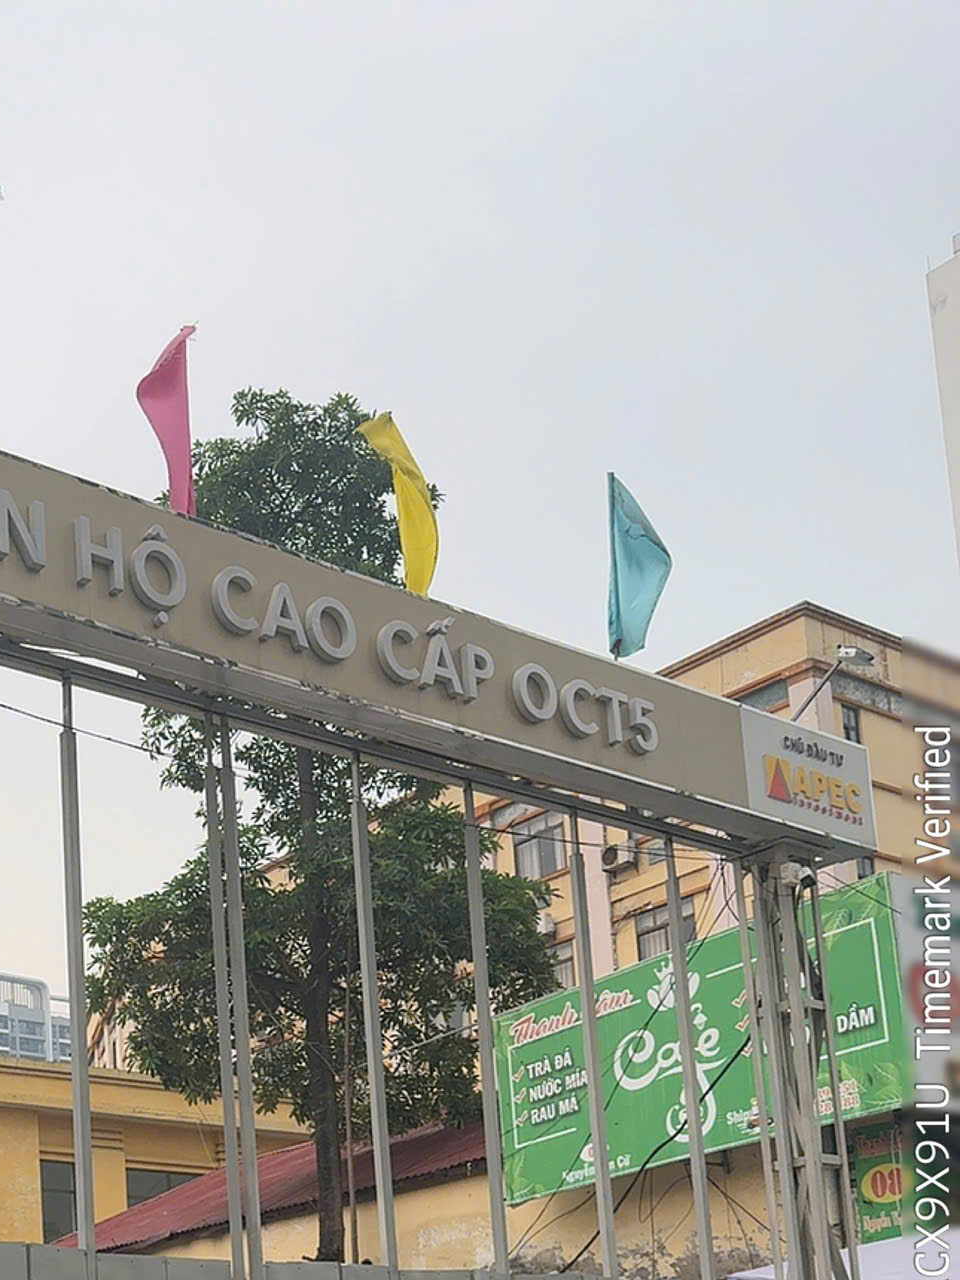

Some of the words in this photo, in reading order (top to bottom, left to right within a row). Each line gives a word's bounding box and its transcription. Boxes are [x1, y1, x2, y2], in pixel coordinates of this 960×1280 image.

[72, 523, 189, 629] HỘ
[211, 565, 359, 663] CAO
[376, 615, 496, 702] CẤP
[512, 662, 659, 756] OCT5
[828, 751, 845, 768] TƯ
[792, 766, 865, 815] APEC
[509, 1001, 579, 1045] Thanh
[835, 1002, 876, 1034] DẦM
[527, 1056, 553, 1079] TRÀ
[554, 1048, 573, 1070] ĐÁ
[529, 1077, 563, 1103] NƯỚC
[530, 1105, 556, 1126] RAU
[559, 1092, 580, 1115] MÁ
